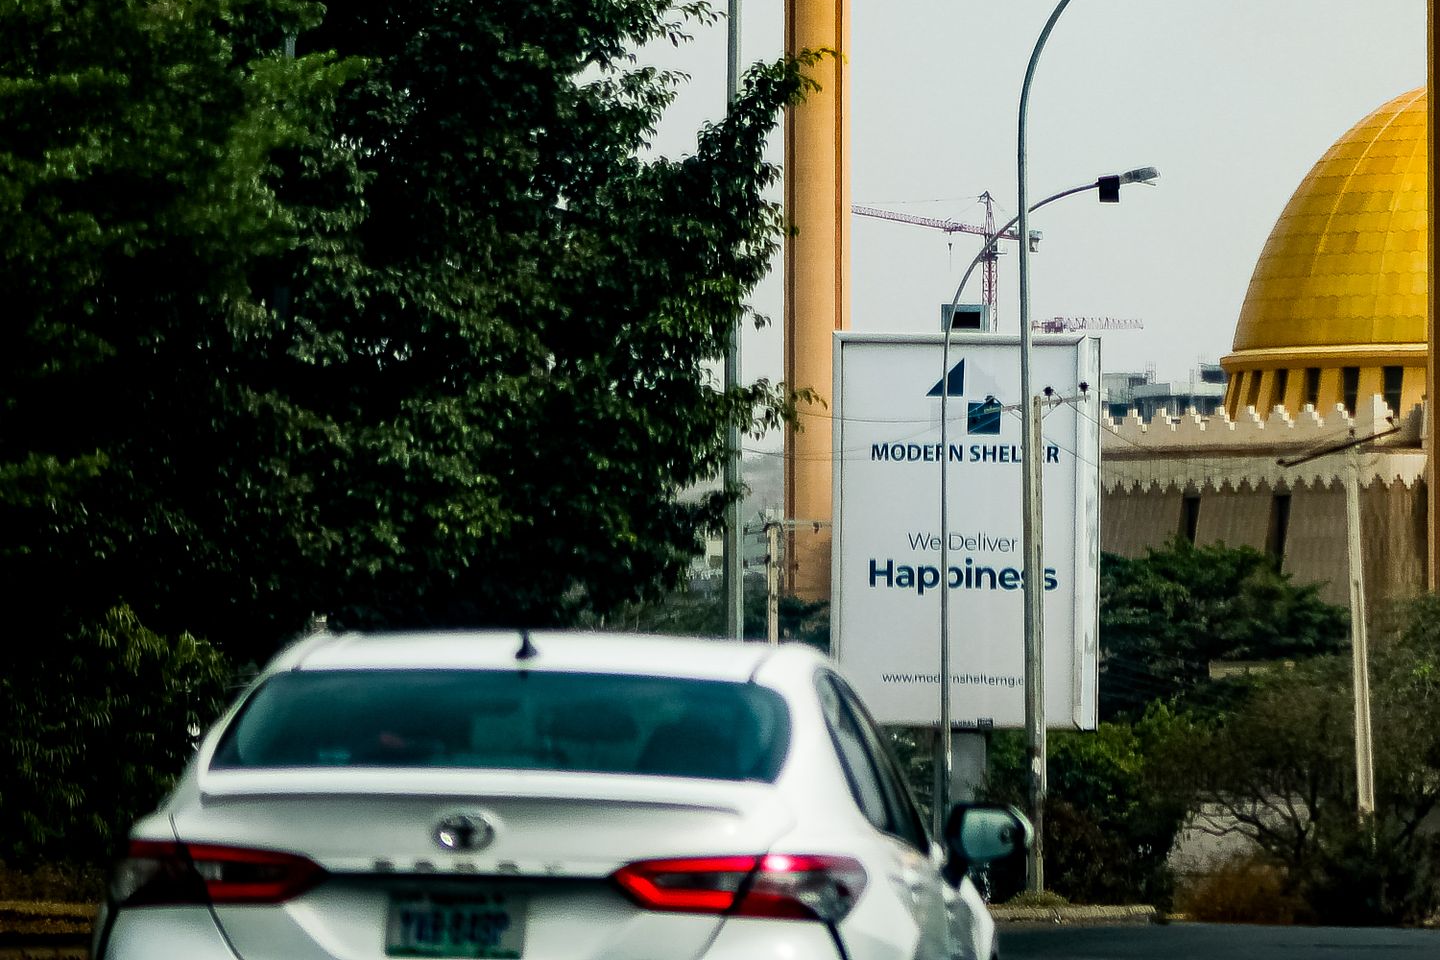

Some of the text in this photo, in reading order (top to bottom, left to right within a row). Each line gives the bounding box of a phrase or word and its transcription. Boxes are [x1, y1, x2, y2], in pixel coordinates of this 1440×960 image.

[871, 443, 1060, 464] MODERN SHELR
[907, 532, 1018, 553] We Deliver
[868, 557, 1059, 596] Happines
[881, 673, 1024, 688] www.modnshelterng.c
